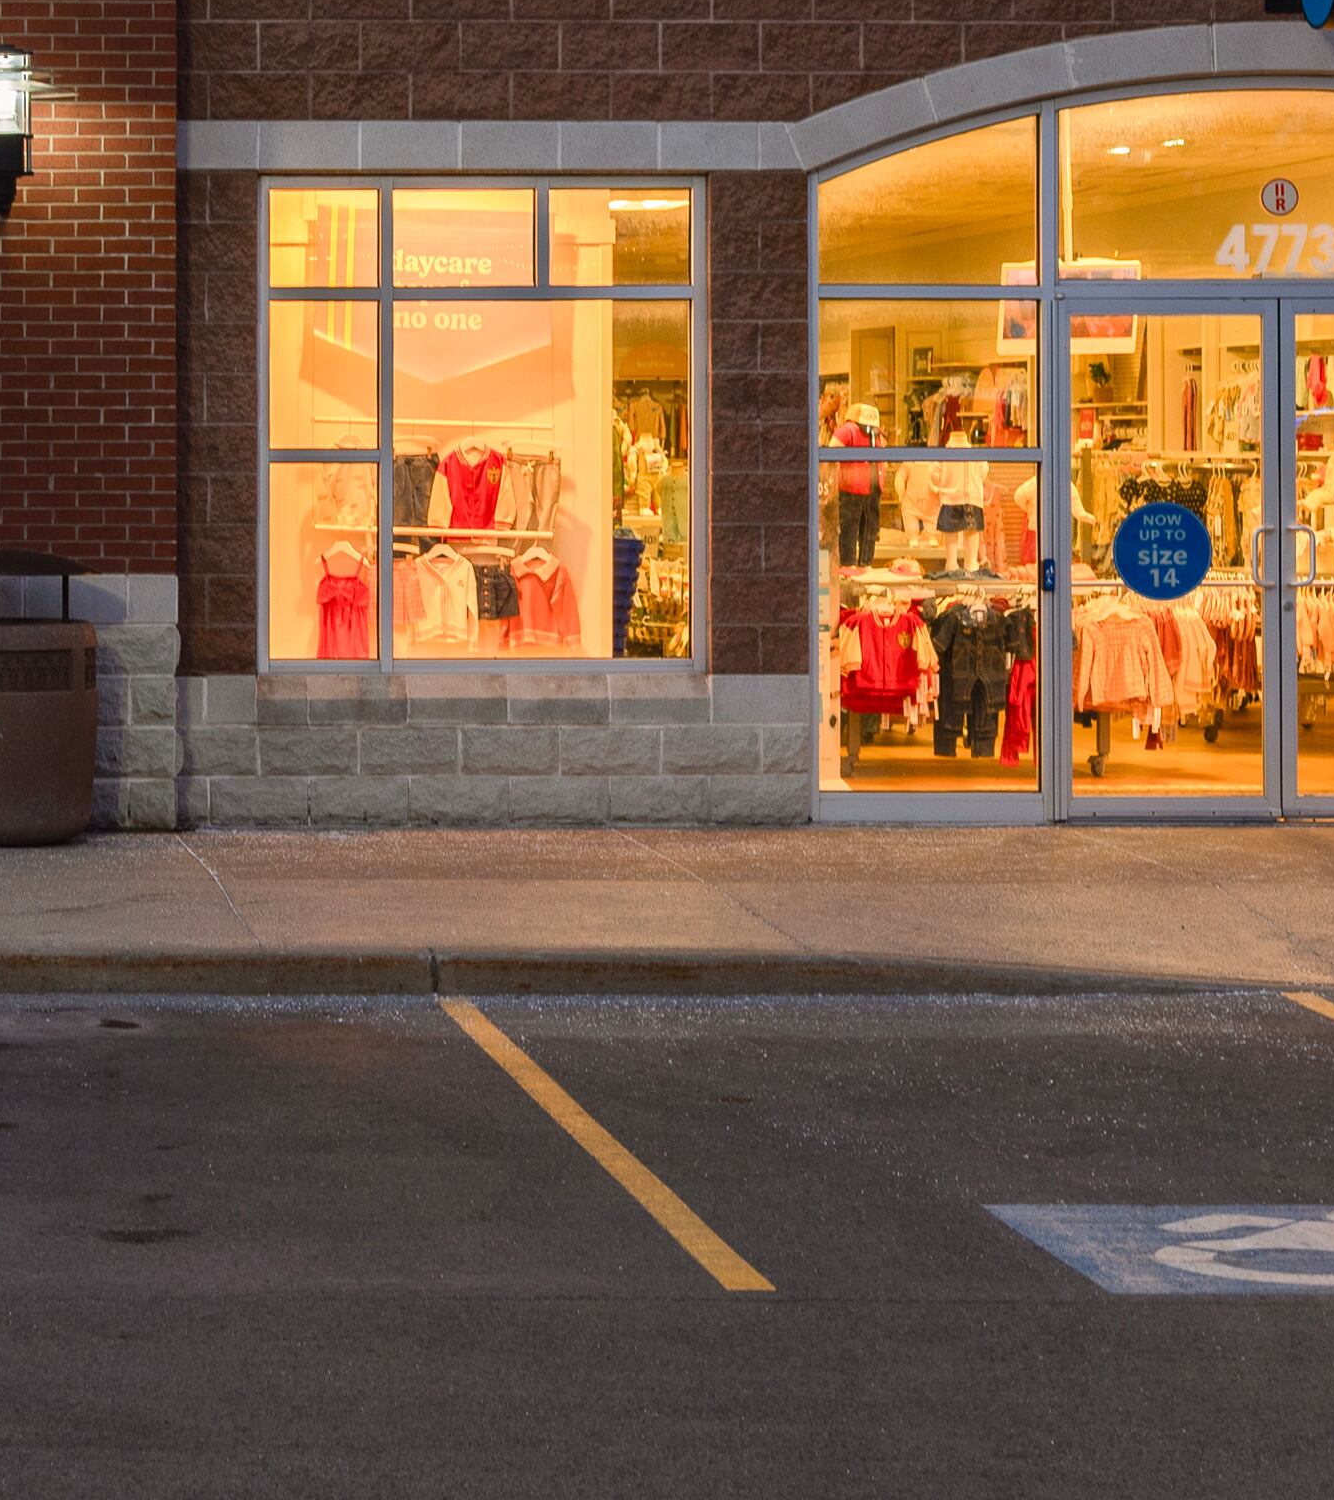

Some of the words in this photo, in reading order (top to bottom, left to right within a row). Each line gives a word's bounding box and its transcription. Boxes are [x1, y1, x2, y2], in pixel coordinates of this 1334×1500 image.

[1275, 198, 1286, 211] R
[393, 249, 492, 279] daycare
[434, 311, 483, 331] one
[1143, 514, 1182, 527] NOW
[1139, 529, 1160, 541] UP
[1164, 529, 1186, 541] TO
[1138, 543, 1188, 565] size
[1150, 567, 1178, 588] 14
